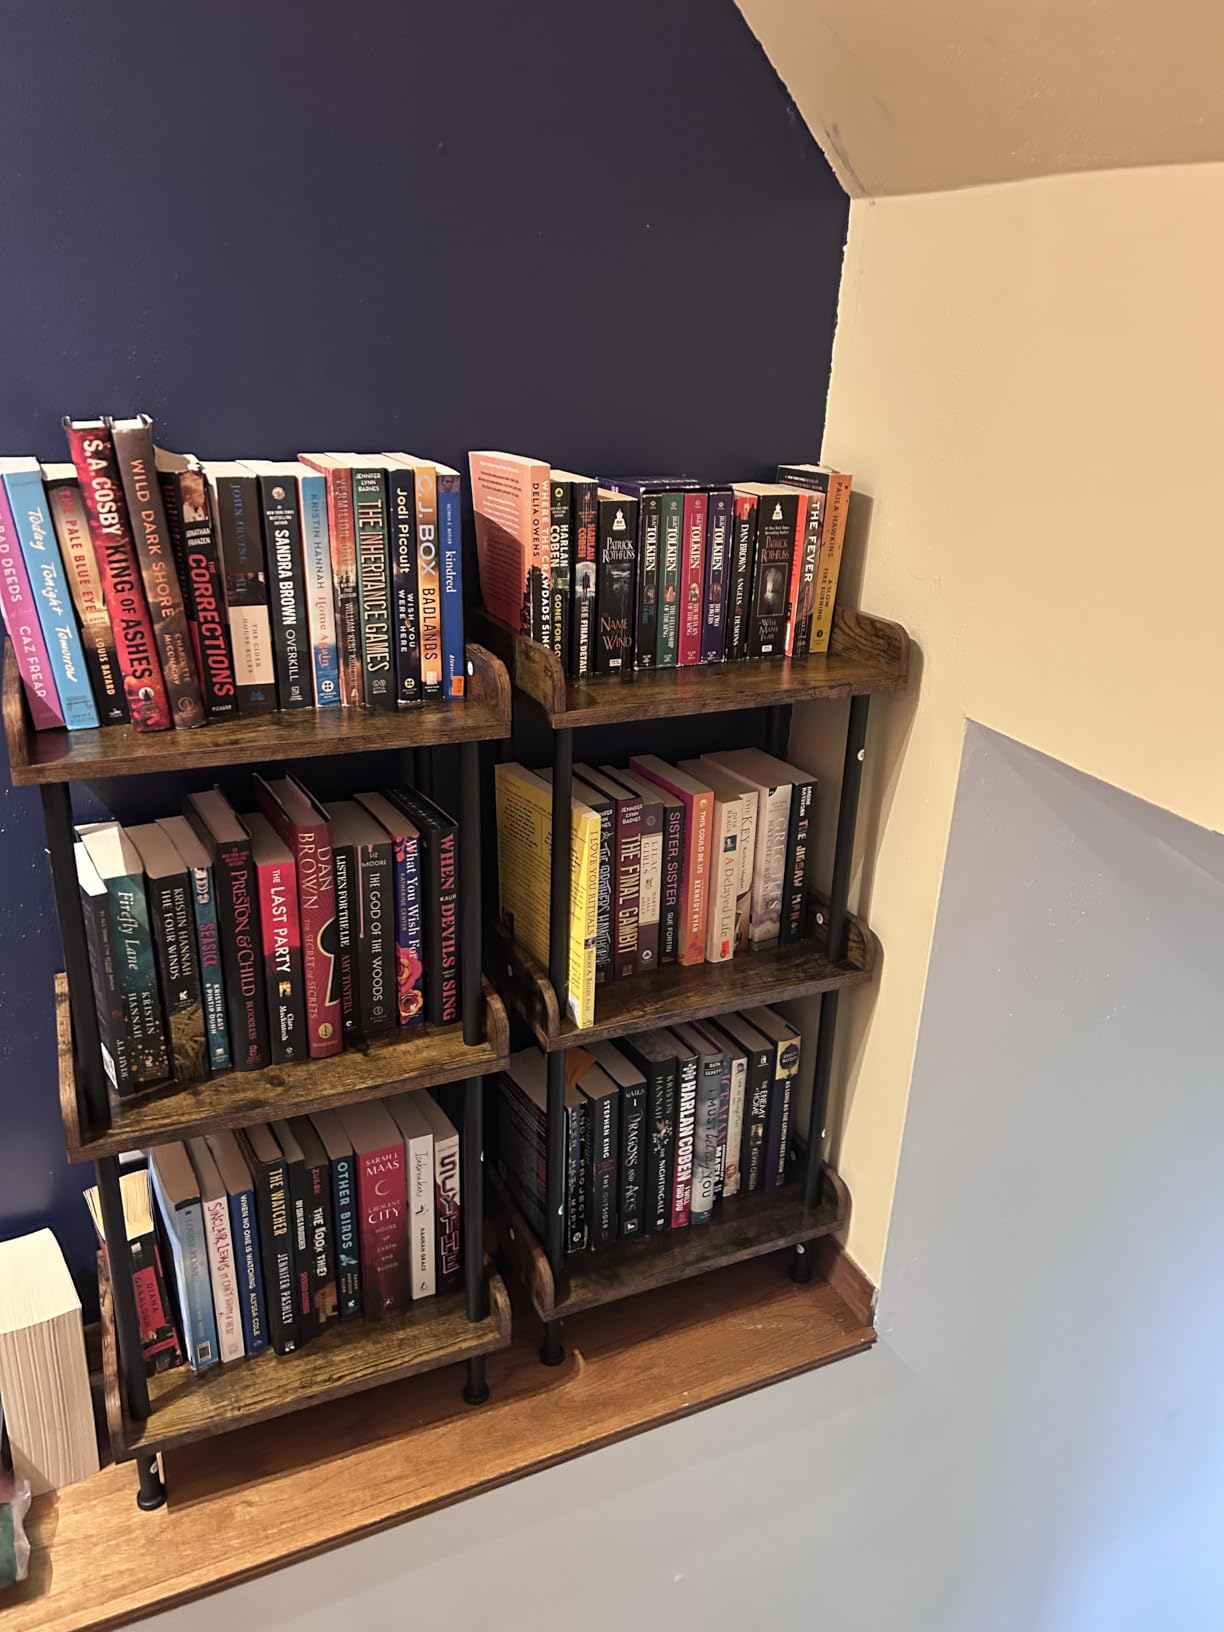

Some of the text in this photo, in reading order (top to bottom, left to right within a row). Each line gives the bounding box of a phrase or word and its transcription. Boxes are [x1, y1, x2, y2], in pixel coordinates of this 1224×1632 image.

[355, 473, 381, 481] JENNIFER
[92, 477, 122, 535] COSBY
[358, 499, 382, 528] THE
[397, 488, 410, 574] Jodi Picoult
[532, 483, 540, 557] DELIA OWENS
[828, 481, 843, 557] PAULA HAWKINS
[130, 460, 174, 617] WILD DARK SHORE
[188, 537, 211, 546] FRANZEN
[275, 529, 293, 579] SANDRA
[311, 493, 325, 589] KRISTIN HANNAH
[419, 525, 436, 576] BOX
[541, 480, 550, 621] WHERE THE CRAWDADS
[550, 525, 560, 567] COBEN
[560, 524, 569, 567] HARLAN
[602, 549, 636, 563] ROTHFUSS
[606, 537, 634, 551] PATRICK
[645, 526, 657, 571] TOLKIEN
[666, 526, 678, 571] TOLKIEN
[690, 524, 703, 569] TOLKIEN
[712, 526, 725, 571] TOLKIEN
[737, 524, 749, 572] DAN BROWN
[804, 501, 821, 582] THE FEVER
[2, 558, 22, 602] DEEDS
[65, 519, 97, 611] PALE BLUE EYE
[445, 551, 457, 593] kindred
[28, 505, 78, 683] Today Tonight Tomorrow
[105, 543, 152, 680] KING OF ASHES
[279, 581, 298, 625] BROWN
[407, 593, 415, 619] WISH
[554, 594, 562, 617] GONE
[188, 554, 235, 697] CORRECTIONS
[398, 590, 408, 653] WERE HERE
[422, 588, 438, 660] BADLANDS
[579, 601, 589, 674] THE FINAL DETAIL
[601, 616, 628, 632] NAME
[602, 635, 632, 650] WIND
[20, 626, 46, 697] CAZ FREAR
[95, 638, 108, 662] LOUIS
[285, 629, 301, 681] OVERKILL
[365, 623, 389, 672] GAMES
[101, 664, 115, 695] BAYARD
[621, 804, 643, 813] JENNIFER
[740, 816, 753, 846] KEY
[361, 860, 387, 868] MOORE
[440, 833, 455, 889] WHEN
[666, 812, 681, 906] SISTER, SISTER
[696, 811, 707, 874] THIS COULD US
[793, 819, 809, 887] THE JIGSAW
[298, 832, 320, 909] BROWN
[316, 846, 333, 892] DAN
[406, 839, 420, 936] What You Wish
[586, 840, 598, 935] LOVE YOU RITUALS
[598, 864, 612, 911] BROTHERS
[618, 833, 641, 953] THE FINAL GAMBIT
[269, 869, 292, 973] THE LAST PARTY
[336, 855, 351, 948] LISTEN FOR THE LIE
[440, 894, 457, 902] KAUR
[692, 880, 701, 933] KENNEDY RYAN
[118, 891, 140, 970] Firefly Lane
[160, 890, 180, 980] THE FOUR WINDS
[174, 888, 191, 976] KRISTIN HANNAH
[200, 922, 217, 968] SEASICK
[369, 873, 383, 1001] THE GOD OF THE WOODS
[441, 902, 457, 968] DEVILS
[665, 927, 674, 953] FORTIN
[235, 936, 256, 997] & CHILD
[128, 993, 143, 1038] HANNAH
[141, 991, 155, 1035] KRISTIN
[308, 982, 318, 1019] SECRETS
[442, 979, 457, 1021] SING
[655, 1076, 664, 1119] HANNAH
[665, 1075, 674, 1114] KRISTIN
[679, 1080, 697, 1138] HARLAN
[751, 1092, 759, 1116] HOME
[757, 1090, 768, 1119] ENEMY
[602, 1099, 611, 1159] STEPHEN KING
[625, 1108, 643, 1167] DRAGONS
[702, 1097, 718, 1198] MUST YOU
[365, 1153, 392, 1166] SARAH
[366, 1160, 400, 1176] MAAS
[676, 1137, 694, 1182] COBEN
[269, 1167, 288, 1237] THE WATCHER
[337, 1161, 353, 1249] OTHER BIRDS
[578, 1159, 586, 1219] PROJECT
[656, 1159, 666, 1215] NIGHTINGALE
[313, 1207, 327, 1253] THE BOOK
[368, 1207, 399, 1224] CITY
[440, 1152, 460, 1274] SCYTHE
[240, 1194, 256, 1290] WHEN NO ONE WATCHING
[277, 1253, 293, 1324] JENNIFER PASHLEY
[252, 1318, 260, 1337] COLE
